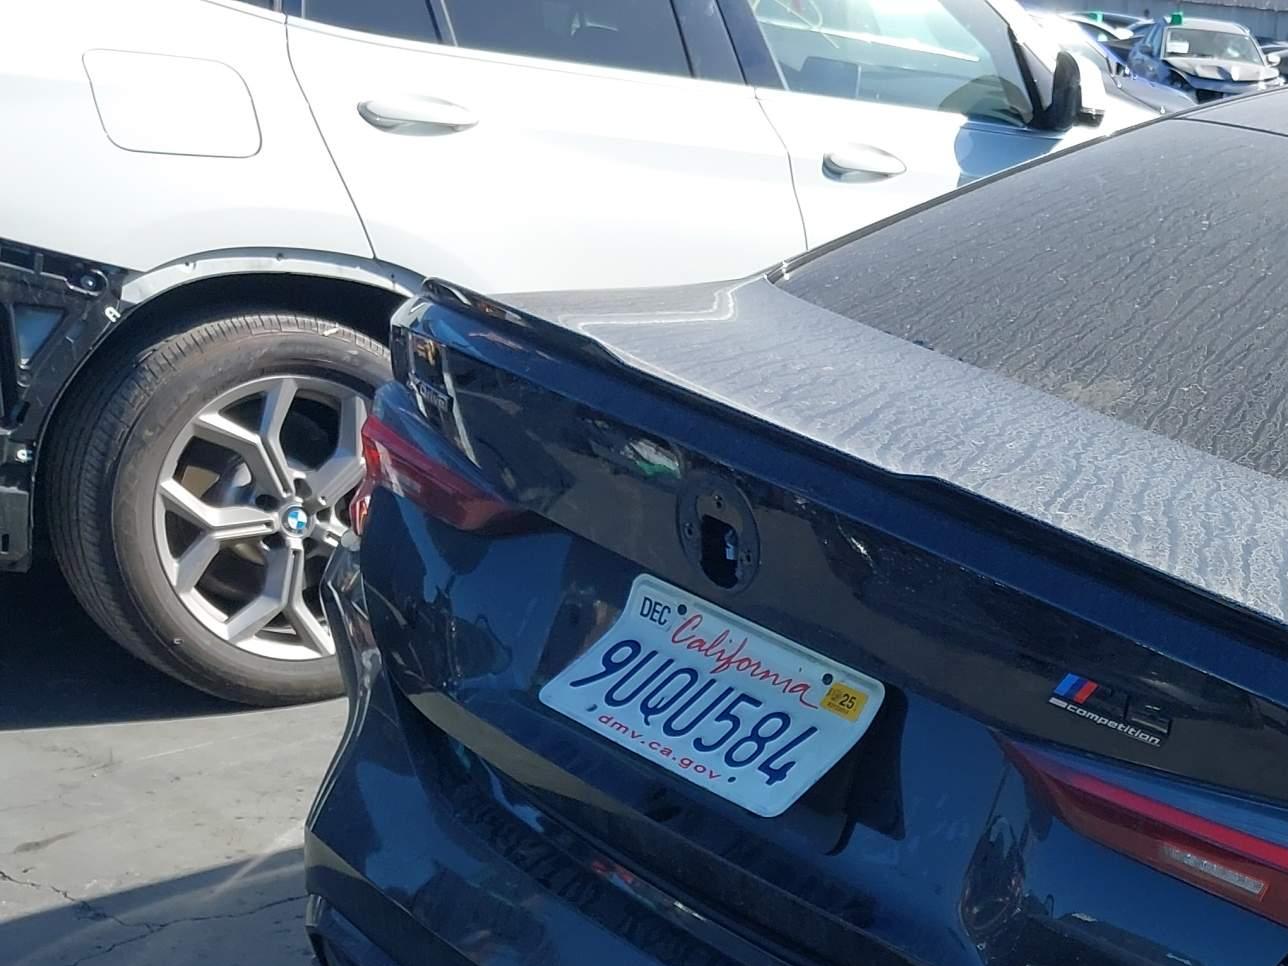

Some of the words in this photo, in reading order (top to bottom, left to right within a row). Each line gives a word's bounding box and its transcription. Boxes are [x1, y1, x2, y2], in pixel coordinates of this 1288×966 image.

[639, 596, 672, 626] DEC
[671, 613, 819, 710] California
[569, 639, 819, 786] 9UQU584
[839, 693, 857, 709] 25
[1066, 705, 1161, 746] competition
[598, 713, 722, 781] dmv.ca.gov
